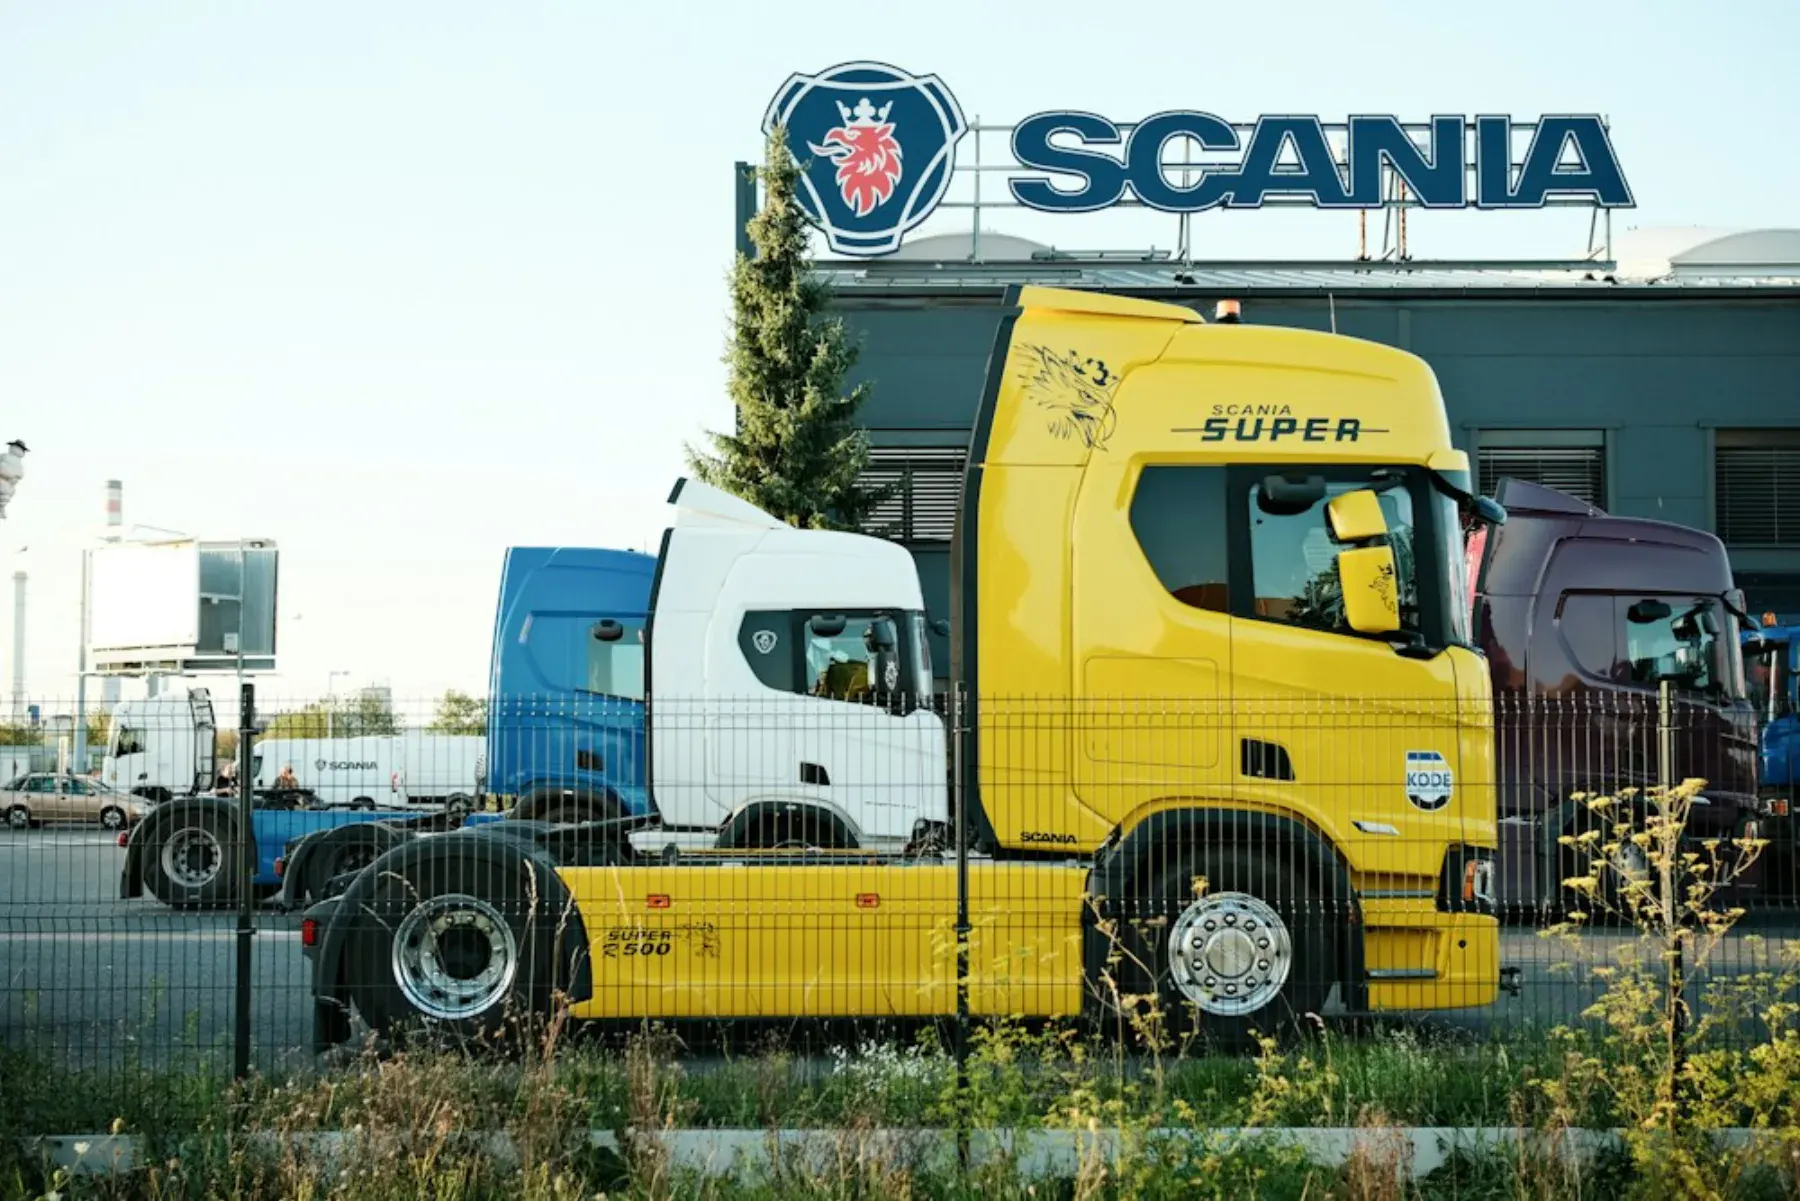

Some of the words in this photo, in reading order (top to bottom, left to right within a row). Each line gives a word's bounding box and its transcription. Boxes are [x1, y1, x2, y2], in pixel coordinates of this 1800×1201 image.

[1008, 110, 1637, 213] SCANIA
[1212, 404, 1292, 416] SCANIA
[1201, 418, 1361, 442] SUPER
[329, 761, 378, 771] SCANIA
[1407, 773, 1450, 787] KODE
[1020, 831, 1077, 844] SCANIA
[608, 931, 671, 941] SUPER
[623, 943, 671, 956] 500
